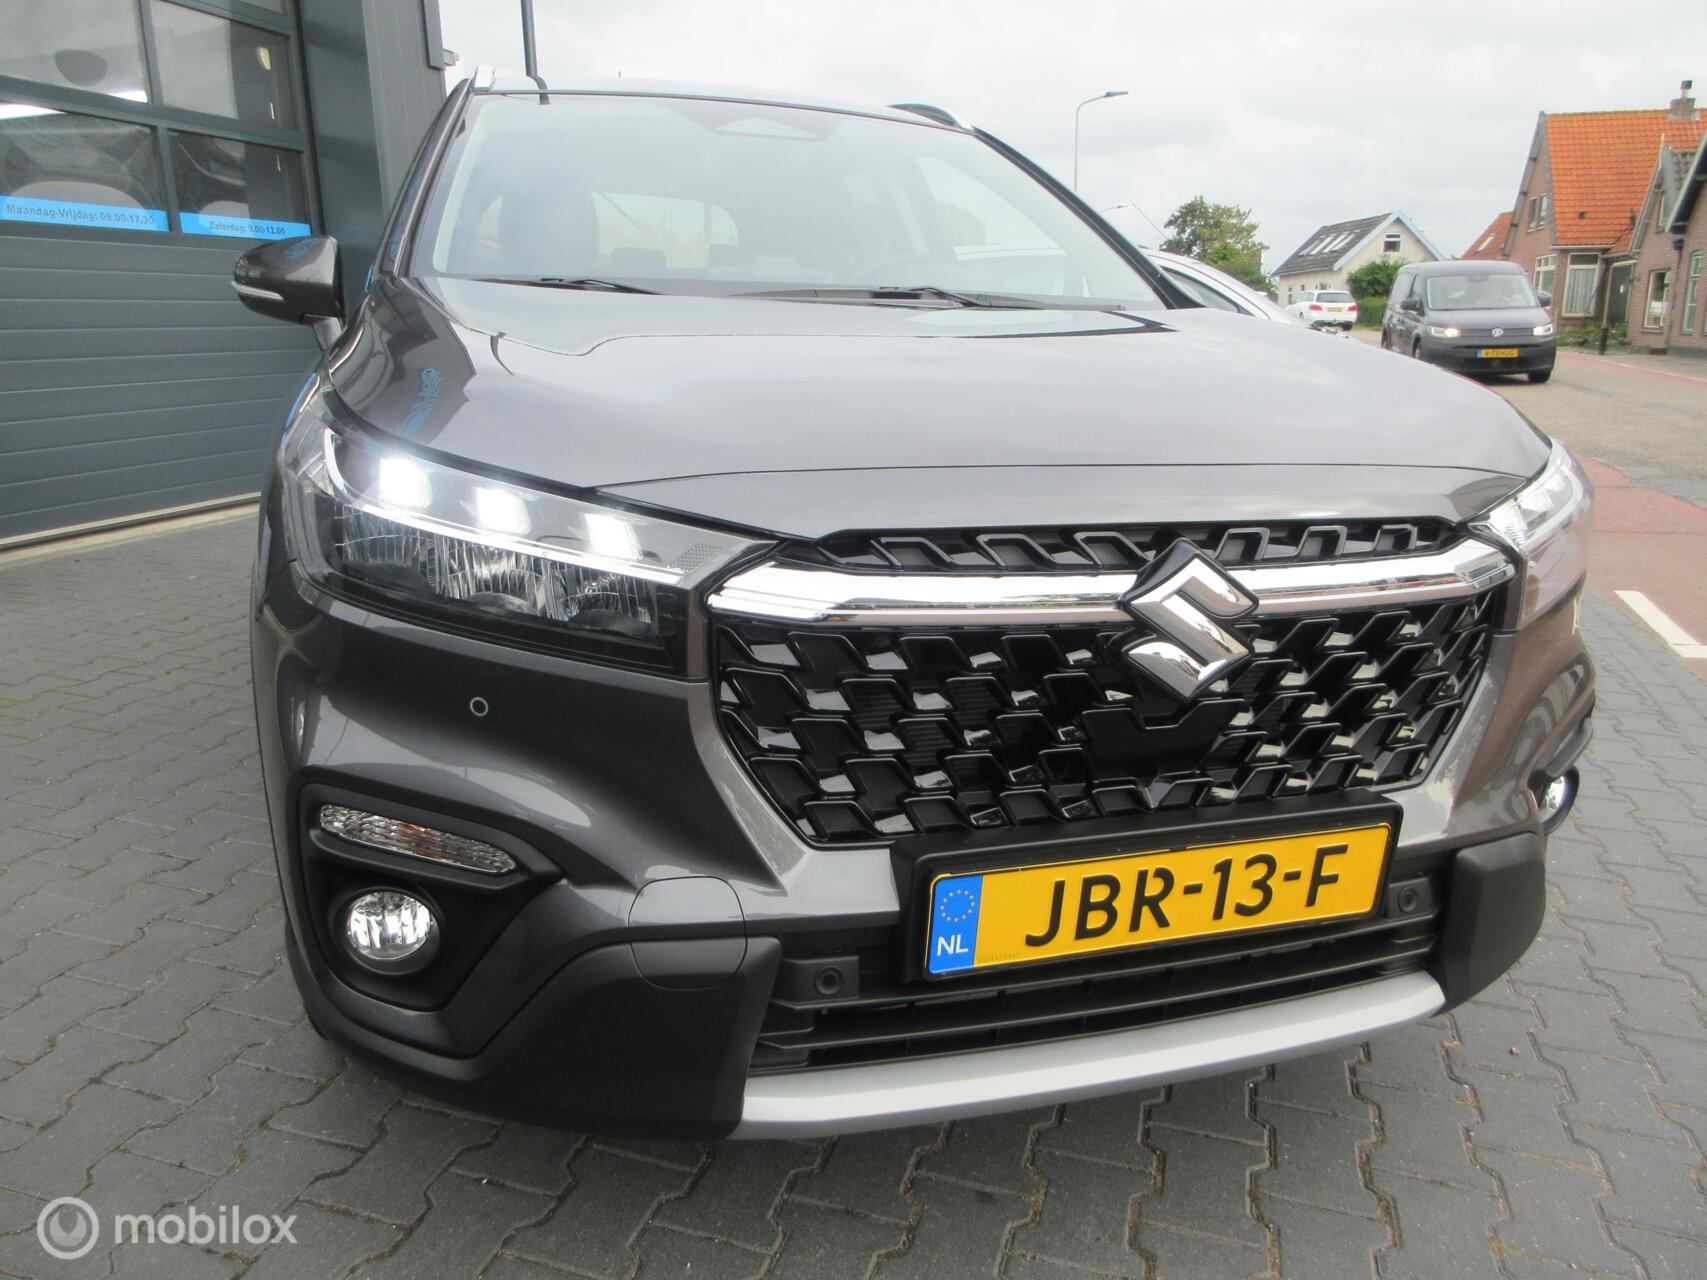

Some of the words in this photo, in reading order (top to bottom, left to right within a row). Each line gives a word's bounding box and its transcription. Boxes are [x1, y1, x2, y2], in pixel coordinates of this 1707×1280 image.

[6, 204, 98, 222] Maandag-Vrijdag:
[101, 211, 154, 225] 08.00-17.30
[209, 222, 246, 234] Zaterdag:
[1024, 843, 1349, 948] JBR-13-F
[936, 933, 969, 956] NL
